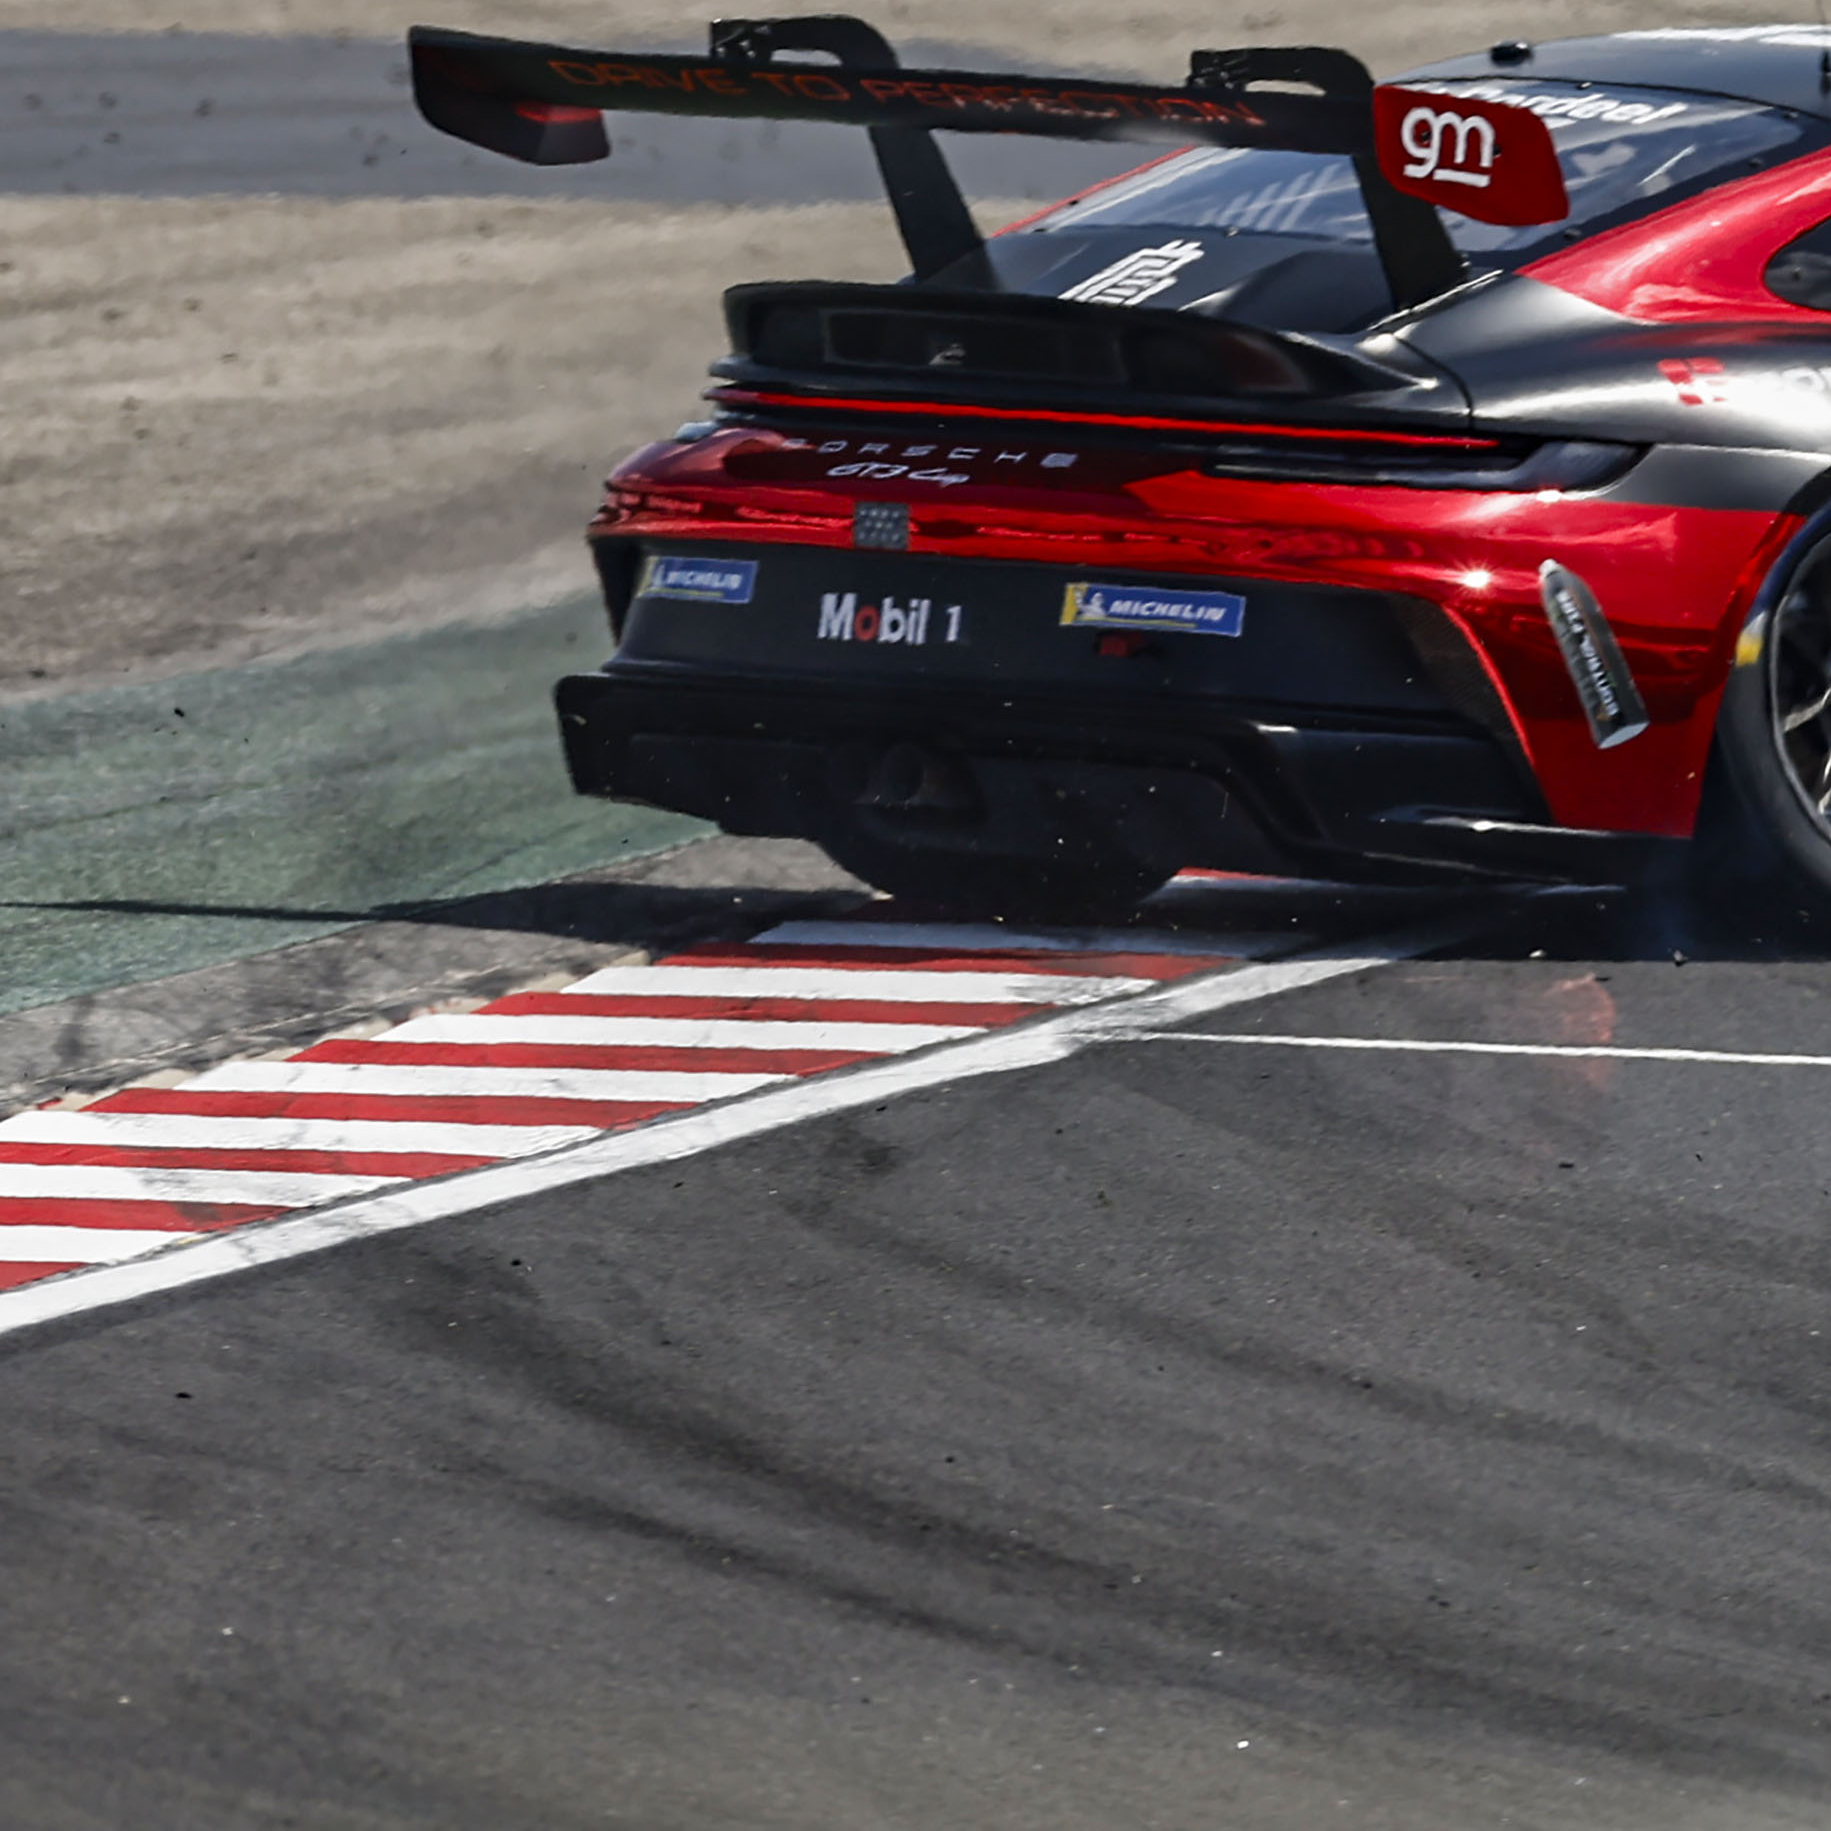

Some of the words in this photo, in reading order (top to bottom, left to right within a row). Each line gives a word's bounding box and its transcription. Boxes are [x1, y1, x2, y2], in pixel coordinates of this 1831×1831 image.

[549, 60, 747, 95] DRIVE
[752, 72, 850, 100] TO
[781, 438, 1078, 469] PORSCHE
[817, 592, 931, 645] Mobil
[945, 605, 962, 642] 1
[1109, 599, 1227, 622] MICHELIN
